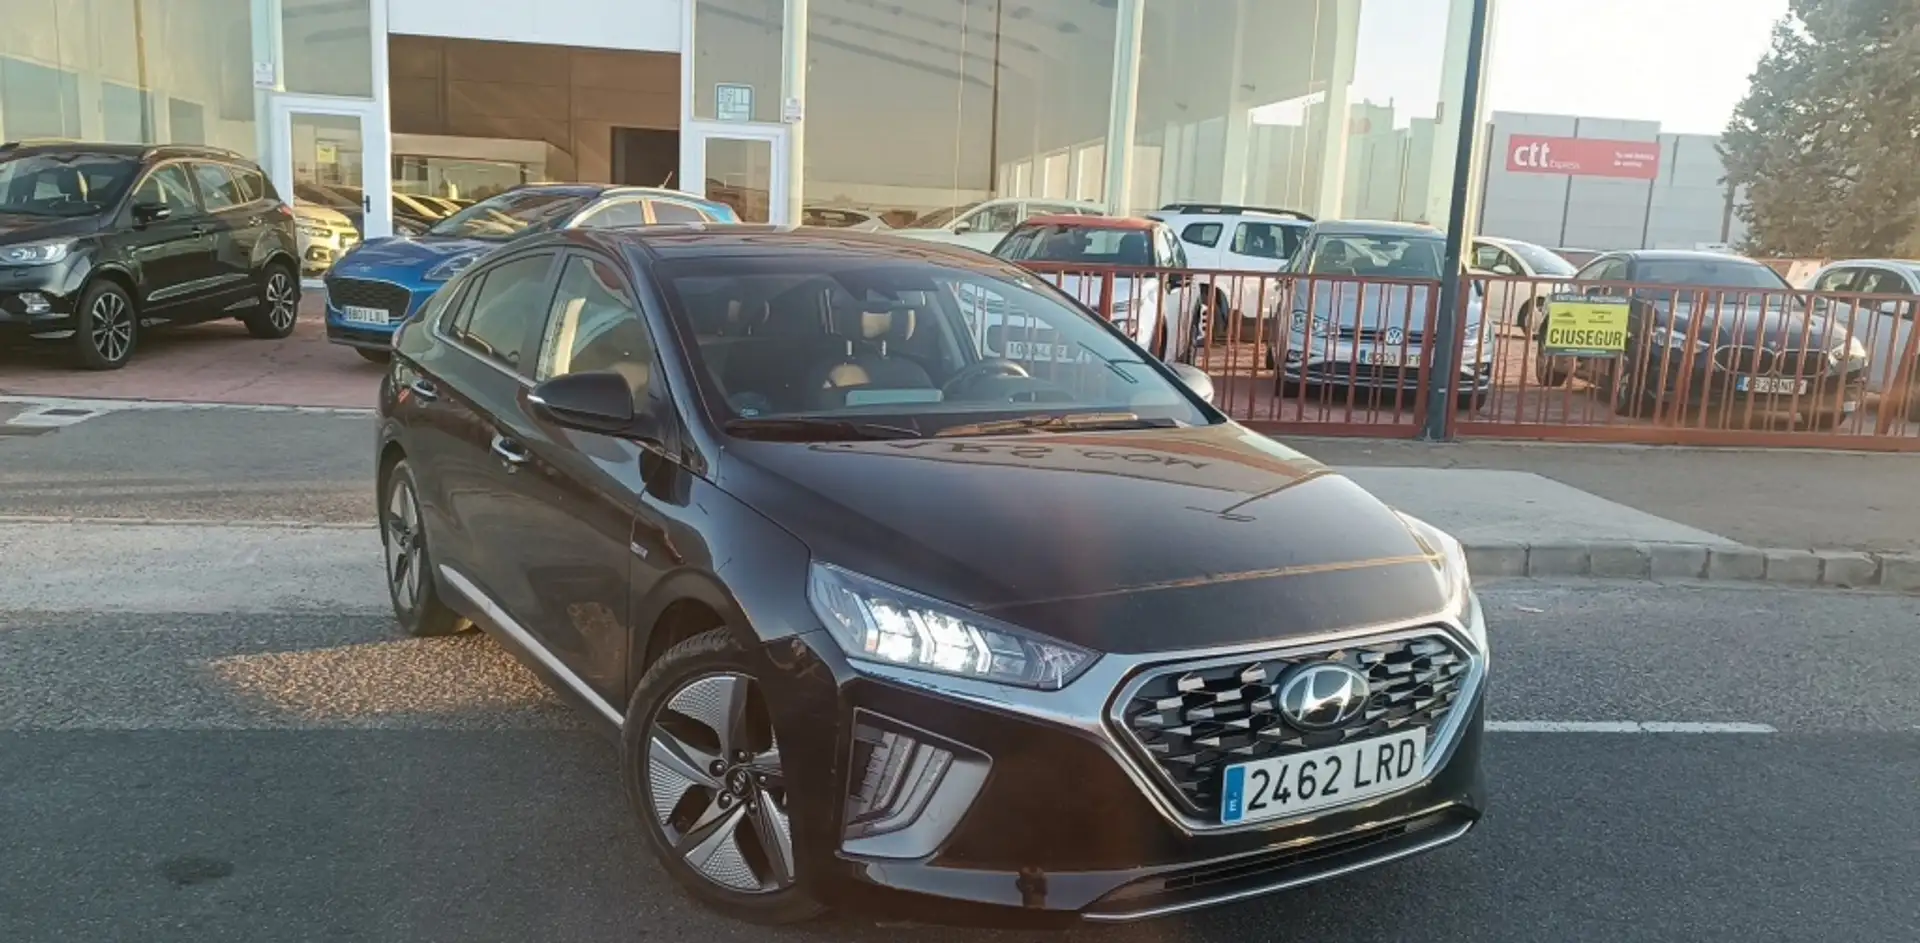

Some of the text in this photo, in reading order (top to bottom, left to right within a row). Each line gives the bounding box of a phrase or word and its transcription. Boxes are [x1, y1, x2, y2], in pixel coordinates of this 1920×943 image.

[1514, 142, 1550, 168] ctt
[1550, 328, 1623, 346] CIUSEGUR
[1248, 738, 1415, 811] 2462 LRD
